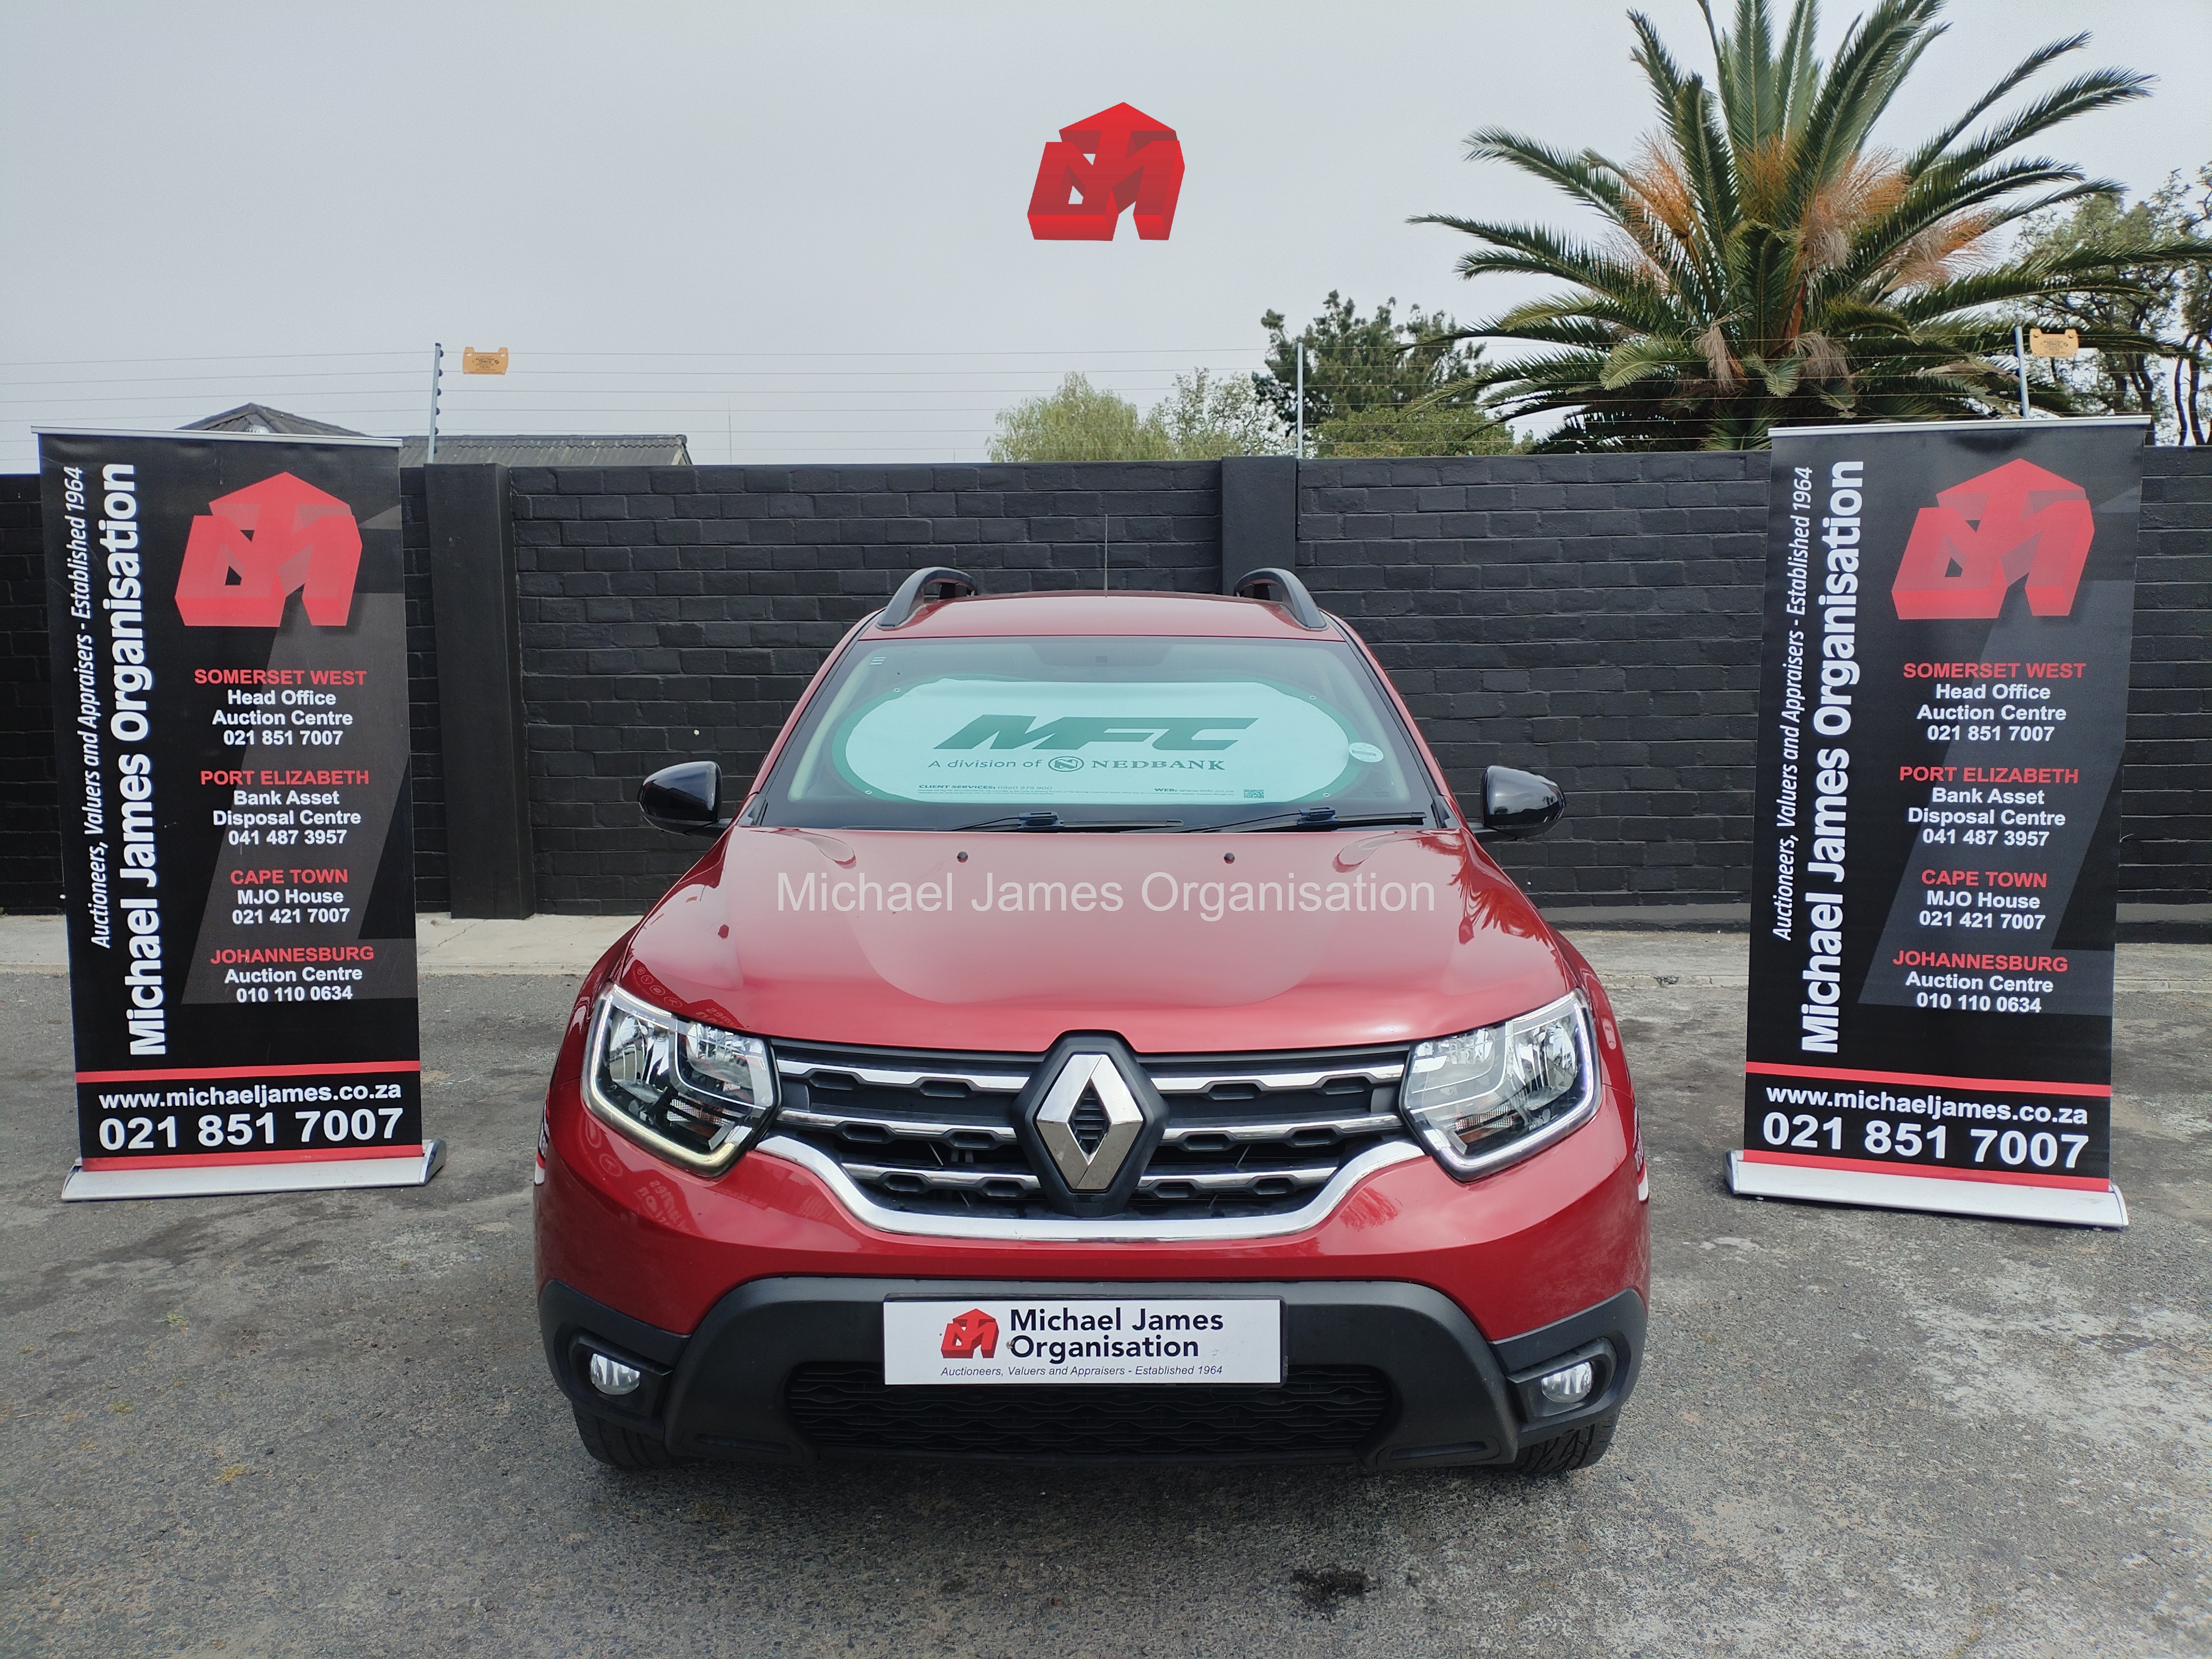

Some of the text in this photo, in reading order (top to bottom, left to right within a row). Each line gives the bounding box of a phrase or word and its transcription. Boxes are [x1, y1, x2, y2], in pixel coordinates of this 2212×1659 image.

[63, 466, 85, 511] 1964
[1792, 467, 1813, 510] 1964
[64, 515, 91, 619] Established
[1786, 515, 1810, 615] Established
[194, 669, 367, 686] SOMERSET WEST
[1781, 630, 1806, 723] Appraisers
[1903, 662, 2087, 679] SOMERSET WEST
[73, 633, 101, 729] Appraisers
[1936, 683, 2051, 699] Head Office
[227, 689, 336, 705] Head Office
[212, 709, 353, 725] Auction Centre
[1917, 704, 2067, 720] Auction Centre
[224, 730, 343, 745] 021 851 7007
[933, 714, 1259, 751] MFC
[1779, 725, 1799, 760] and
[1927, 725, 2055, 741] 021 851 7007
[77, 730, 99, 766] and
[1801, 461, 1864, 1053] Michael James Organisation
[98, 464, 166, 1055] Michael James Organisation
[928, 759, 1225, 770] A division of NEDBANK
[200, 770, 369, 786] PORT ELIZABETH
[1899, 766, 2079, 784] PORT ELIZABETH
[81, 770, 103, 834] Valuers
[234, 790, 340, 805] Bank Asset
[1776, 764, 1798, 827] Valuers
[1932, 787, 2045, 805] Bank Asset
[213, 810, 361, 828] Disposal Centre
[1908, 807, 2066, 827] Disposal Centre
[228, 829, 347, 845] 041 487 3957
[1923, 828, 2050, 846] 041 487 3957
[230, 868, 348, 885] CAPE TOWN
[1921, 869, 2047, 888] CAPE TOWN
[87, 841, 110, 949] Auctioneers,
[237, 889, 344, 905] MJO House
[1772, 834, 1799, 941] Auctioneers,
[1927, 890, 2040, 909] MJO House
[232, 908, 350, 925] 021 421 7007
[1919, 910, 2046, 930] 021 421 7007
[210, 946, 374, 965] JOHANNESBURG
[1893, 950, 2068, 972] JOHANNESBURG
[224, 966, 363, 983] Auction Centre
[1905, 971, 2054, 993] Auction Centre
[236, 985, 353, 1003] 010 110 0634
[1916, 992, 2042, 1013] 010 110 0634
[98, 1084, 401, 1109] www.michaeljames.co.za
[1766, 1087, 2089, 1125] www.michaeljames.co.za
[99, 1108, 403, 1150] 021 851 7007
[1763, 1112, 2089, 1168] 021 851 7007
[1010, 1307, 1223, 1331] Michael James
[1010, 1334, 1199, 1365] Organisation
[941, 1367, 1003, 1376] Auctioneers,
[1008, 1366, 1046, 1375] Valuers
[1049, 1366, 1068, 1375] and
[1070, 1366, 1125, 1377] Appraisers
[1135, 1366, 1195, 1375] Established
[1198, 1365, 1222, 1374] 1964
